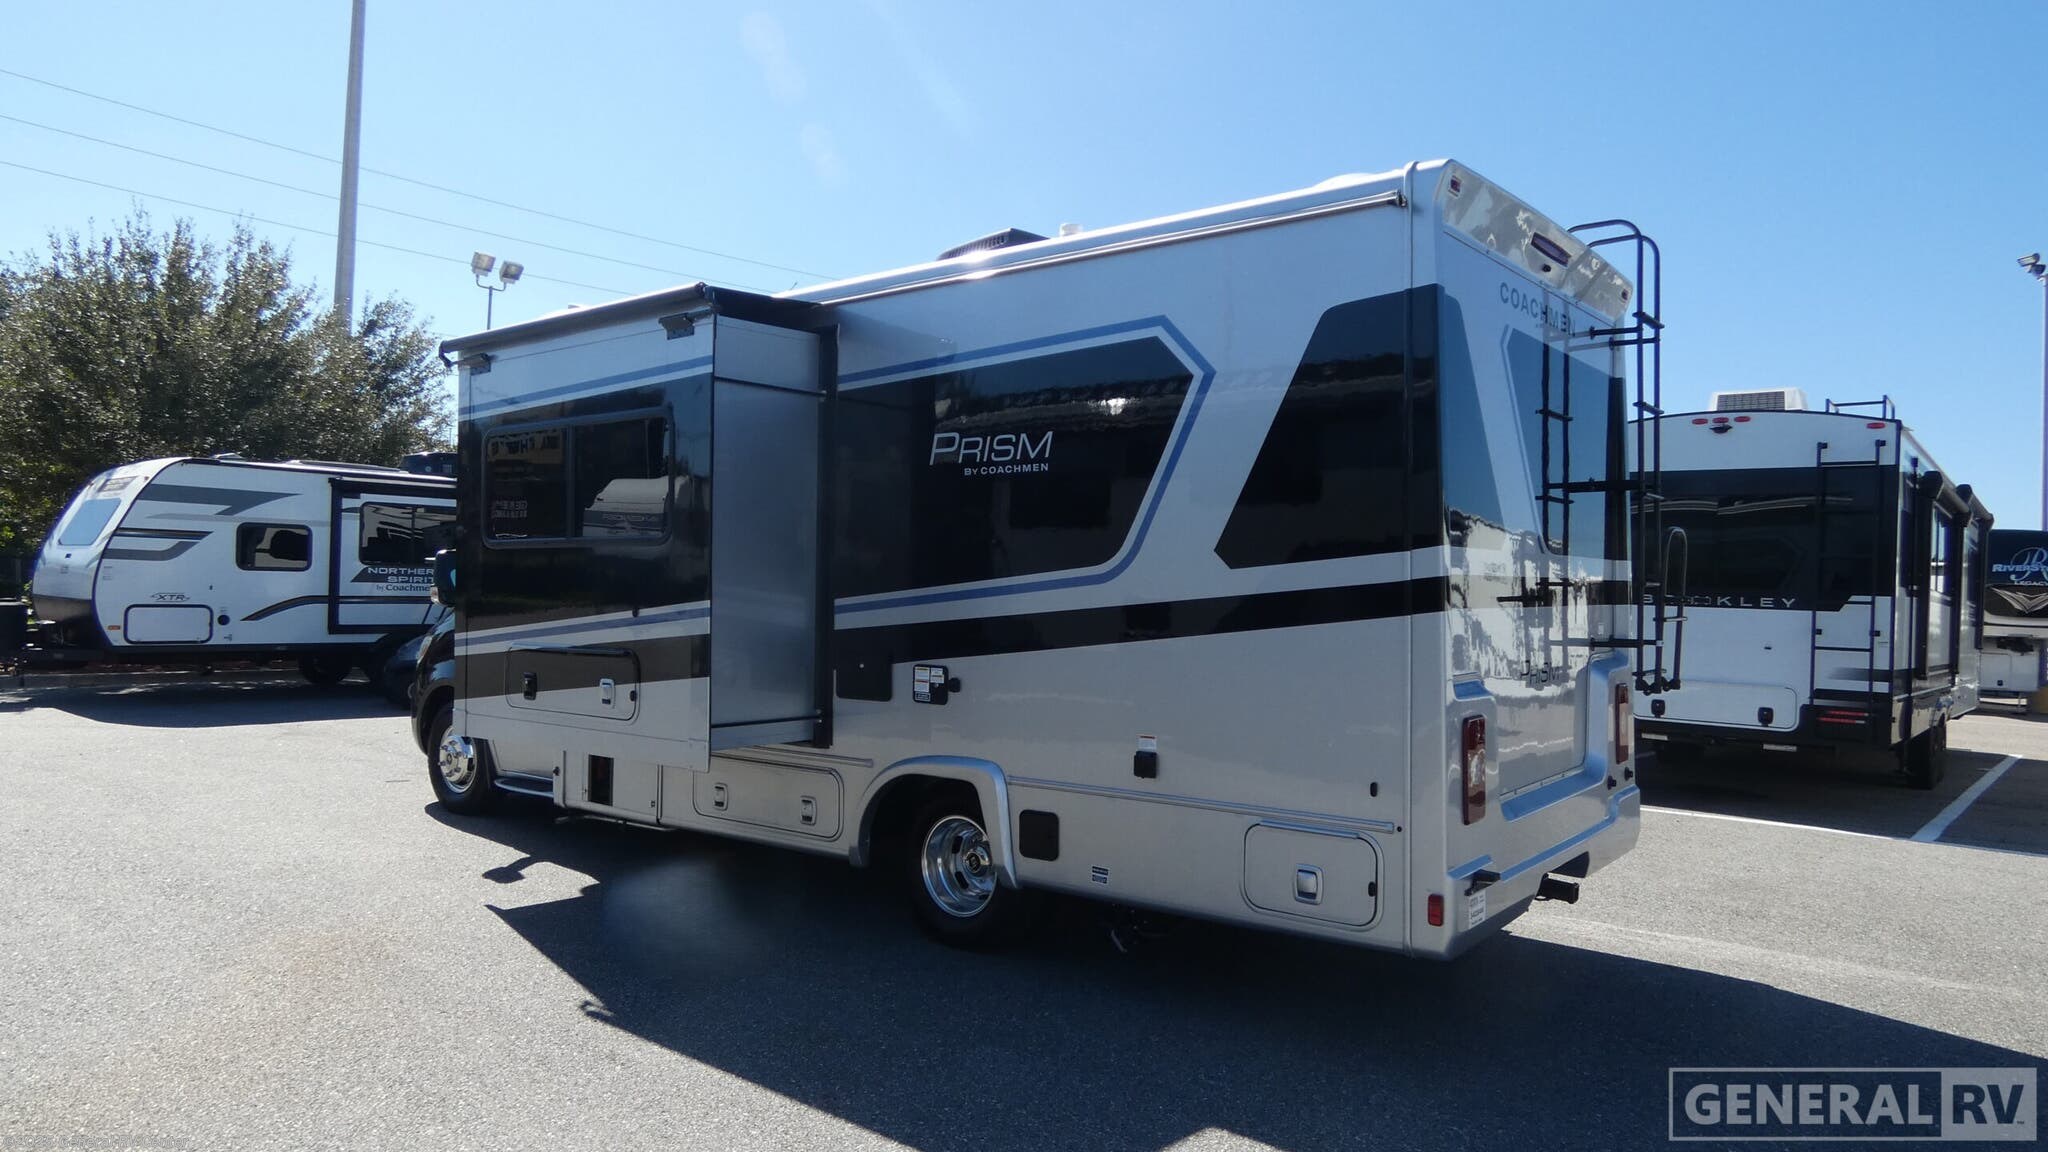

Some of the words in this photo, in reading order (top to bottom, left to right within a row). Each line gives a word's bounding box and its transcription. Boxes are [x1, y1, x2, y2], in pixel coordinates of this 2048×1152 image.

[929, 431, 1053, 465] PRISM
[964, 467, 979, 476] BY
[980, 463, 1049, 475] COACHMEN
[367, 567, 435, 575] NORTHER
[1992, 564, 2048, 572] RIVERST
[386, 584, 431, 592] Coachme
